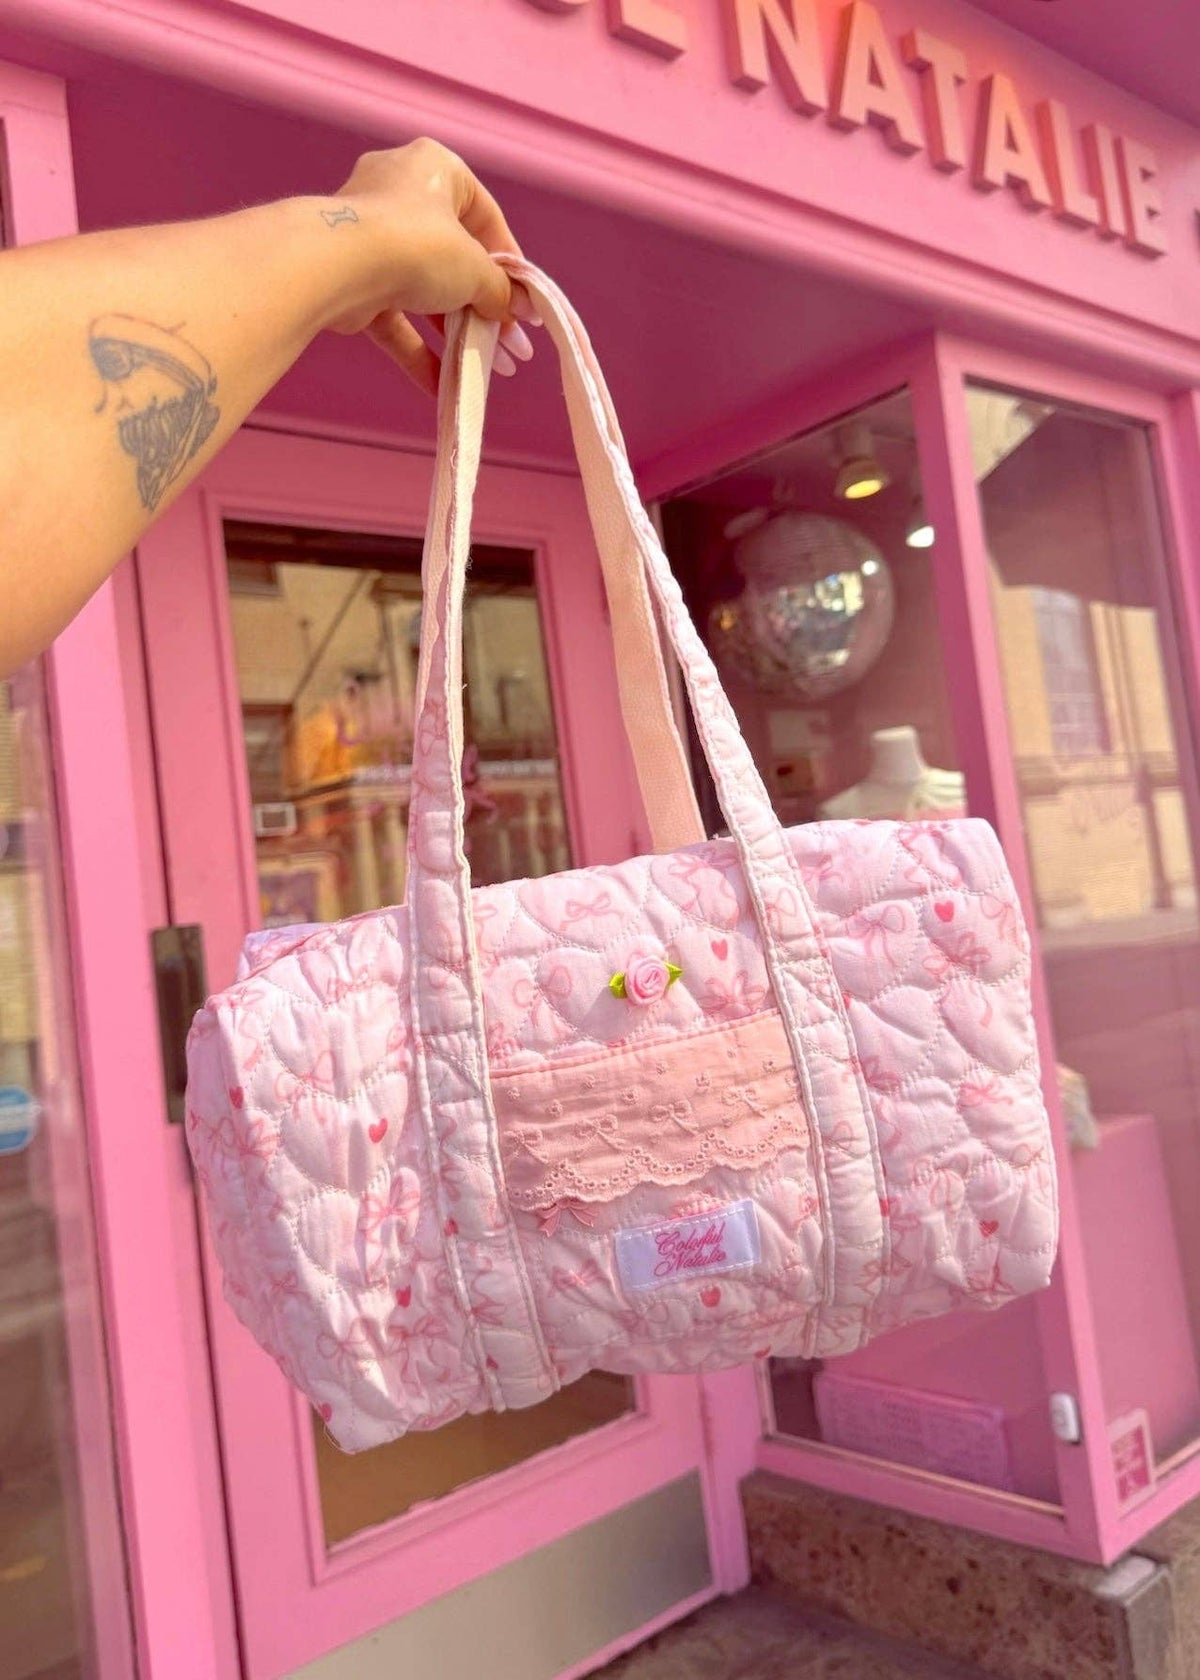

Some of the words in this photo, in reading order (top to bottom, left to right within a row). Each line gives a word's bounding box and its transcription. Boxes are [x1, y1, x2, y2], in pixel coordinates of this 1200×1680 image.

[728, 0, 1165, 258] NATALIE
[655, 1221, 726, 1257] Colorful
[654, 1244, 727, 1277] Natalie
